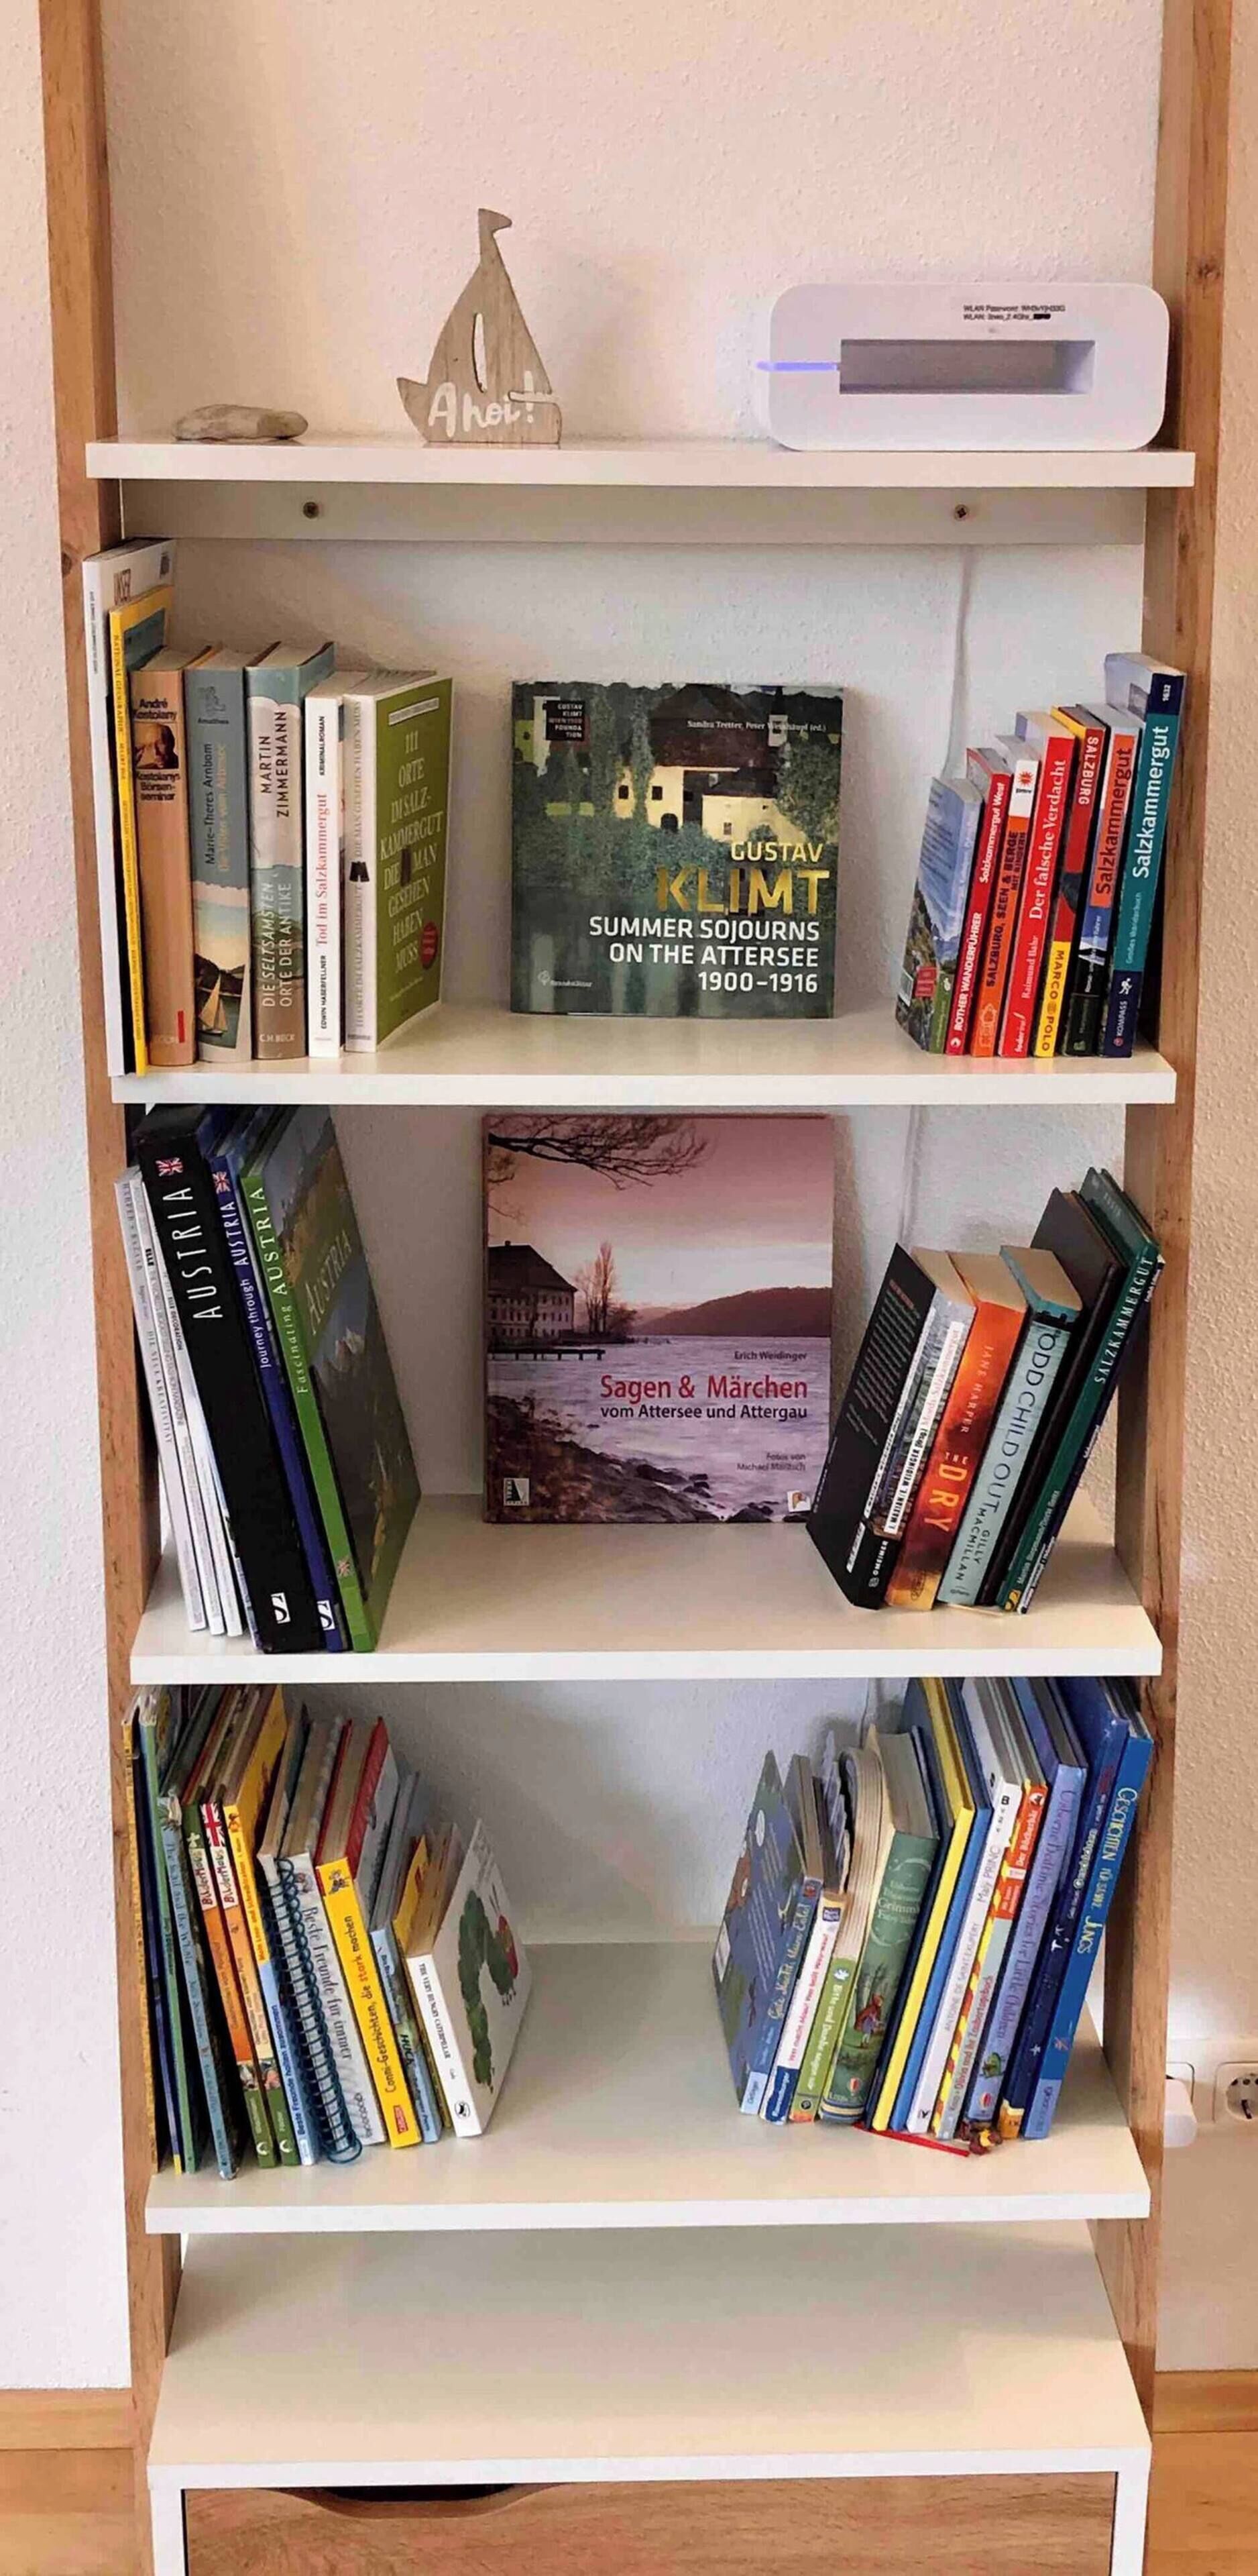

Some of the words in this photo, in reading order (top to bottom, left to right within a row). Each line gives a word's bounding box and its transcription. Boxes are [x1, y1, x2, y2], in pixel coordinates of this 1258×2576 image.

[428, 370, 534, 437] Ahoi!
[139, 698, 168, 708] André
[687, 720, 714, 729] Sandra
[202, 743, 214, 788] Arnbom
[258, 736, 272, 794] MARTIN
[274, 711, 290, 818] ZIMMERMANN
[398, 757, 424, 788] ORTE
[1078, 736, 1099, 805] SALZBURG
[1041, 759, 1066, 829] Verdacht
[1132, 726, 1170, 879] Salzkammergut
[203, 792, 215, 865] Marie-Theres
[380, 810, 443, 861] KAMMERGUT
[978, 807, 1001, 883] Salzkammergut
[992, 782, 1005, 806] West
[1095, 748, 1132, 895] Salzkammergut
[315, 794, 329, 899] Salzkammergut
[730, 843, 823, 863] GUSTAV
[1003, 830, 1019, 871] BERGE
[1033, 831, 1055, 887] falsche
[384, 861, 400, 890] DIE
[656, 867, 830, 916] KLIMT
[1002, 875, 1012, 884] &
[278, 883, 293, 935] ANTIKE
[315, 903, 327, 919] im
[388, 875, 430, 918] GESEHEN
[996, 888, 1010, 919] SEEN
[1029, 889, 1046, 920] Der
[260, 882, 276, 980] SELTSAMSTEN
[315, 925, 328, 947] Tod
[393, 907, 423, 947] HABEN
[589, 916, 693, 939] SUMMER
[699, 919, 820, 944] SOJOURNS
[280, 939, 293, 966] DER
[396, 940, 418, 973] MUSS
[609, 943, 643, 963] ON
[650, 945, 694, 965] THE
[701, 946, 819, 967] ATTERSEE
[960, 912, 982, 992] WANDERFÜHRER
[986, 922, 1006, 987] SALZBURG,
[280, 971, 293, 1007] ORTE
[1021, 958, 1036, 999] Raimund
[1049, 949, 1065, 1000] MARCO
[262, 985, 276, 1007] DIE
[954, 993, 969, 1032] ROTHER
[1041, 1016, 1055, 1051] POLO
[1117, 1000, 1128, 1036] KOMPASS
[162, 1187, 223, 1319] AUSTRIA
[220, 1201, 249, 1266] AUSTRIA
[248, 1187, 288, 1296] AUSTRIA
[144, 1248, 155, 1267] ELLE
[239, 1278, 260, 1324] through
[305, 1228, 352, 1336] AUSTRIA
[1094, 1255, 1153, 1385] SALZKAMMERGUT
[251, 1325, 272, 1368] Journey
[280, 1304, 308, 1394] Fascinating
[734, 1350, 758, 1360] Erich
[759, 1351, 807, 1362] Weidinger
[977, 1345, 994, 1377] JANE
[1025, 1332, 1056, 1387] ODD
[600, 1375, 671, 1404] Sagen
[678, 1375, 695, 1399] &
[707, 1375, 808, 1399] Märchen
[960, 1383, 983, 1434] HARPER
[600, 1407, 634, 1418] vom
[638, 1404, 702, 1418] Attersee
[706, 1405, 736, 1418] und
[740, 1404, 807, 1422] Attergau
[1001, 1391, 1036, 1457] CHILD
[902, 1449, 921, 1487] WEIDINGER
[944, 1452, 969, 1465] THE
[924, 1463, 968, 1532] DRY
[984, 1462, 1011, 1514] OUT
[955, 1507, 988, 1580] MACMILLAN
[973, 1529, 991, 1564] GILLY
[982, 1846, 1002, 1879] PRINC
[1016, 1851, 1027, 1866] Der
[249, 1909, 258, 1923] und
[300, 1906, 323, 1941] Beste
[343, 1915, 360, 1953] machen
[311, 1944, 339, 1995] Freunde
[355, 1955, 369, 1982] stark
[419, 1963, 427, 1976] THE
[423, 1977, 433, 1993] VERY
[1009, 1960, 1031, 1993] Little
[361, 1985, 374, 1999] die
[428, 1993, 439, 2018] HUNGRY
[271, 2004, 287, 2049] zusammen
[825, 2005, 836, 2023] und
[944, 1995, 961, 2031] ANTOINE
[996, 1994, 1020, 2039] Children
[335, 2021, 353, 2060] immer
[367, 2001, 396, 2094] Conni-Geschichten,
[433, 2019, 451, 2059] CATERPILLAR
[280, 2050, 292, 2077] halten
[954, 2068, 968, 2090] Olivia
[962, 2052, 972, 2068] und
[284, 2077, 302, 2112] Freunde
[292, 2112, 306, 2136] Beste
